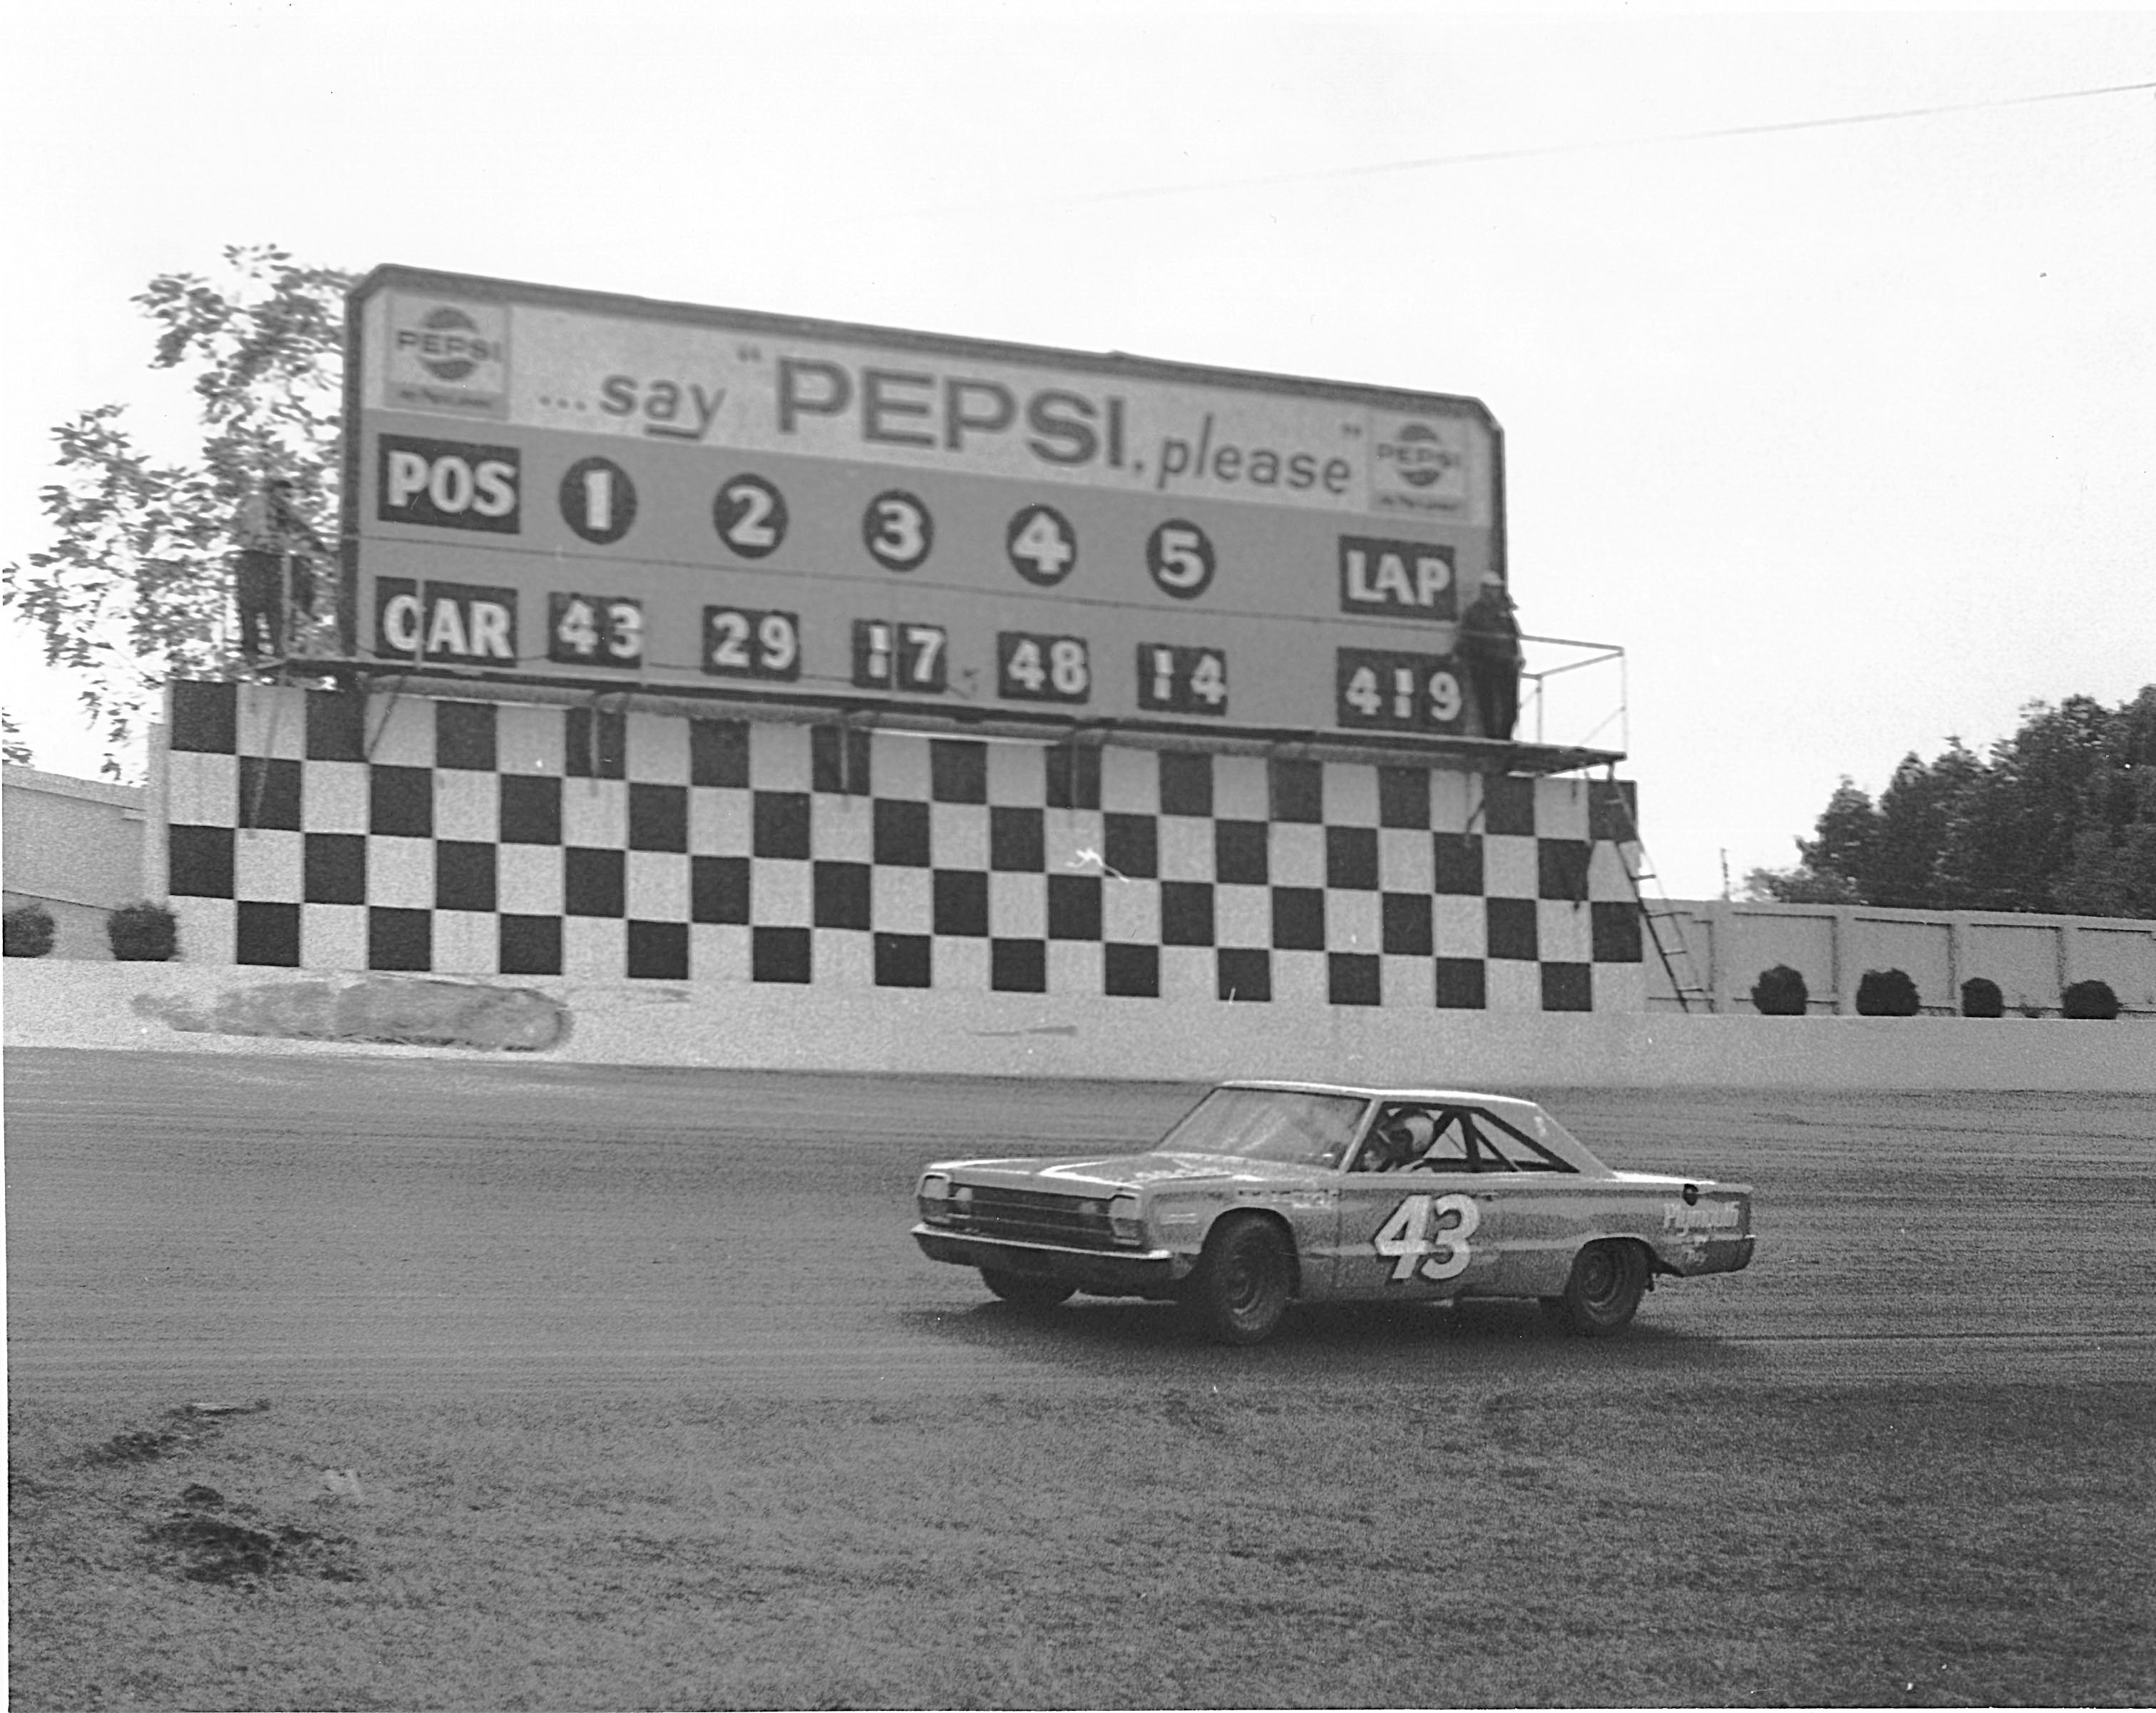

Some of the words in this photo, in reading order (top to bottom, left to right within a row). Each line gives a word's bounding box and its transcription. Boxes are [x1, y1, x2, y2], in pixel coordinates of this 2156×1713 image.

[538, 375, 726, 440] ...say
[388, 451, 518, 518] POS
[581, 470, 612, 531] 1
[727, 485, 776, 547] 2
[871, 500, 925, 562] 3
[1011, 511, 1072, 574] 4
[1158, 529, 1207, 588] 5
[1346, 551, 1452, 607] LAP
[382, 595, 513, 659] CAR
[558, 599, 642, 658] 43
[714, 612, 796, 670] 29
[867, 627, 944, 682] 17
[1008, 640, 1087, 695] 48
[1153, 649, 1226, 704] 14
[1346, 668, 1462, 722] 419
[1375, 1193, 1479, 1279] 43
